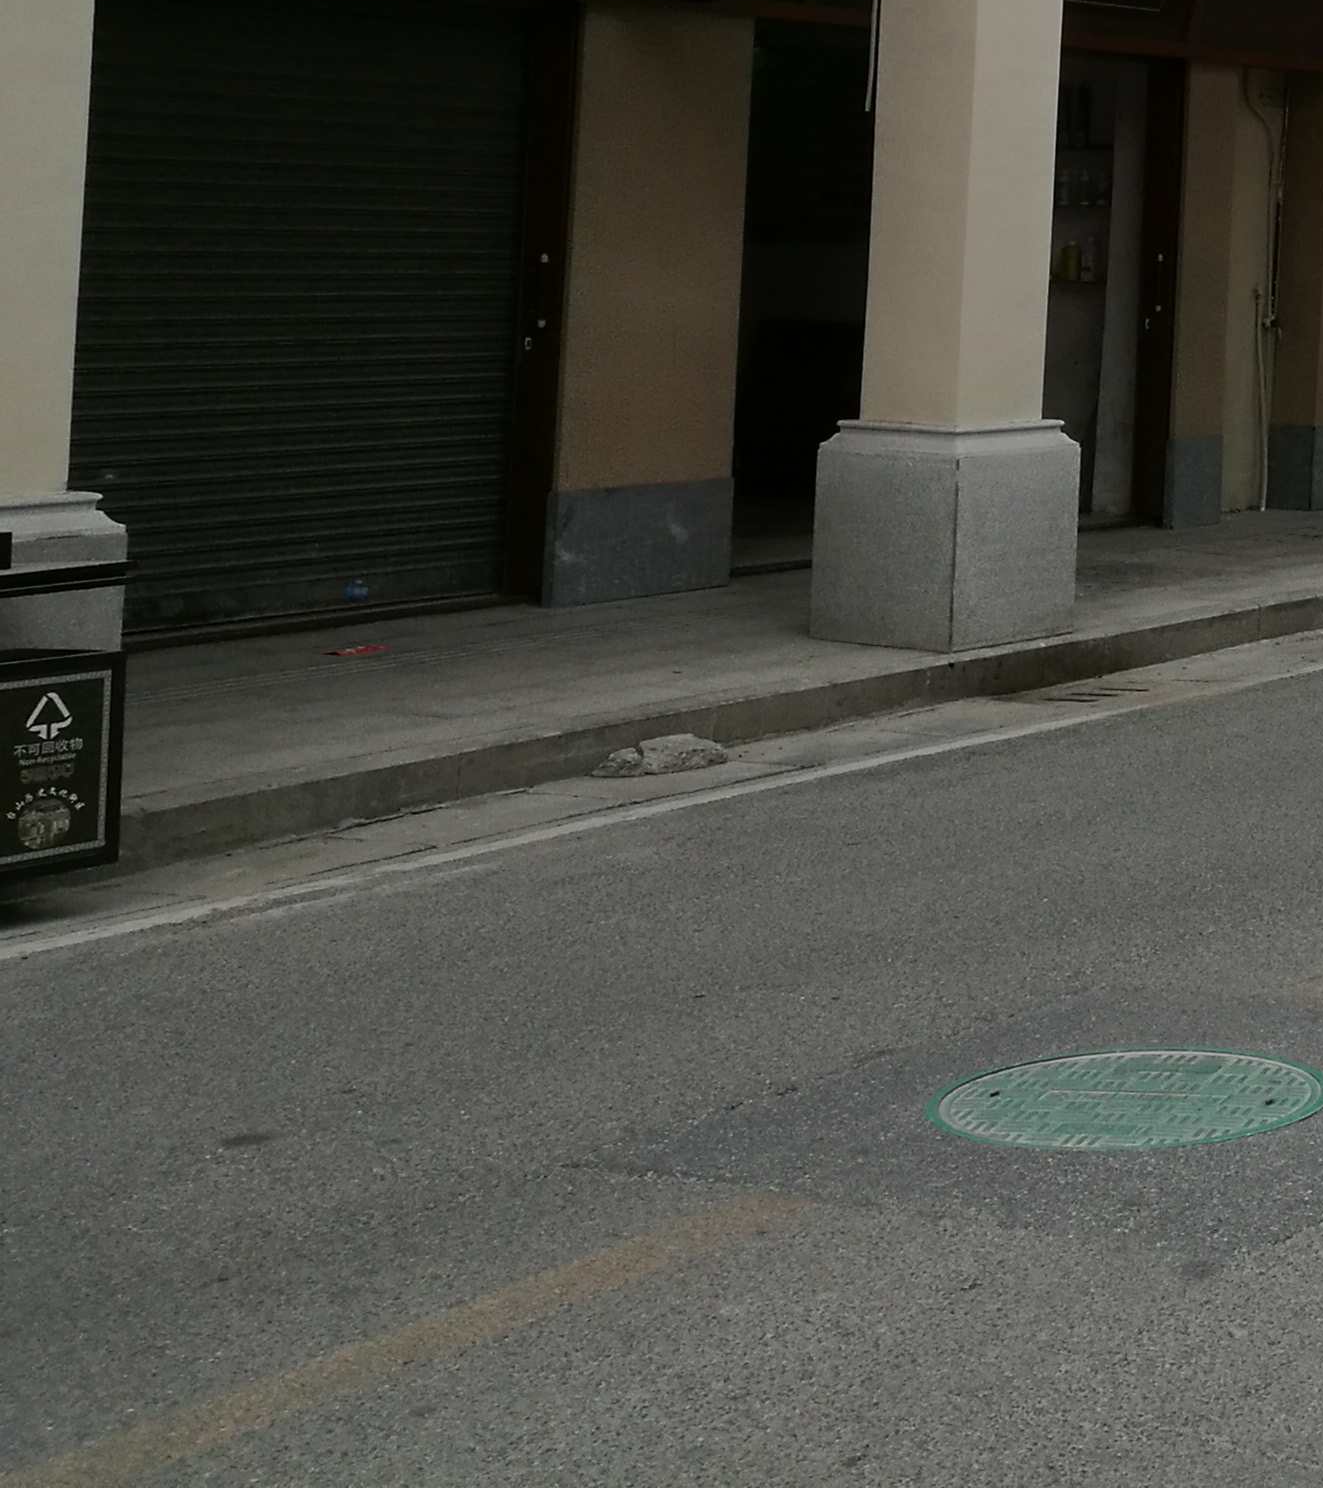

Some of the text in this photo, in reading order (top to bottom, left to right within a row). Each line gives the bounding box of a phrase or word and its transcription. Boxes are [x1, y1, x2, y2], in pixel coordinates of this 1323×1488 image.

[14, 738, 83, 757] 不可回收物
